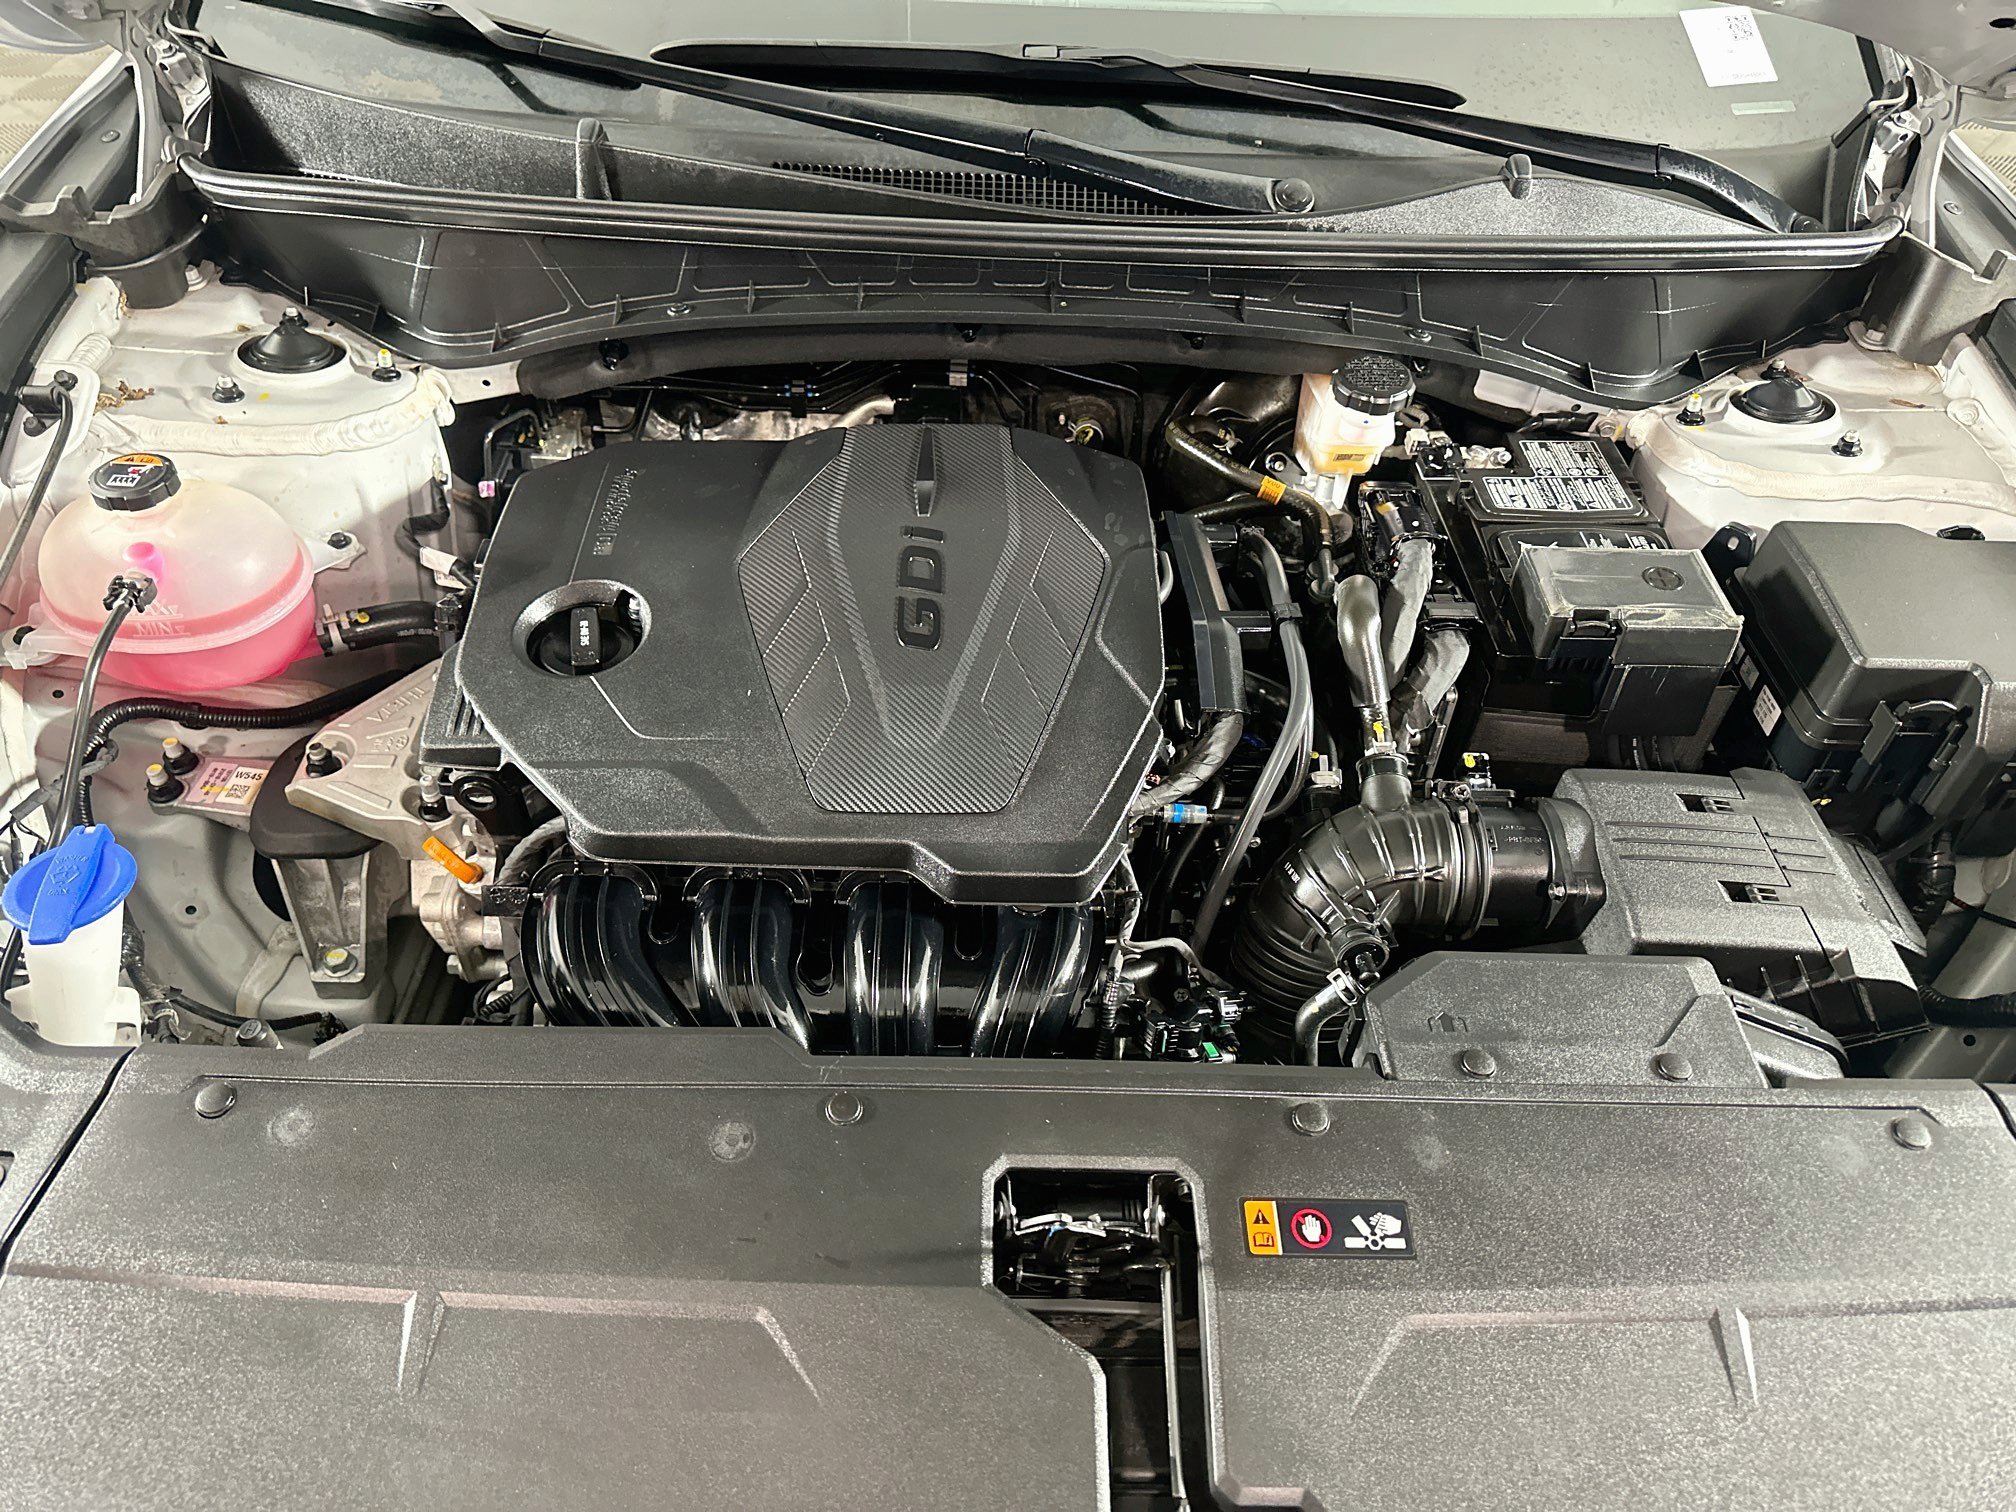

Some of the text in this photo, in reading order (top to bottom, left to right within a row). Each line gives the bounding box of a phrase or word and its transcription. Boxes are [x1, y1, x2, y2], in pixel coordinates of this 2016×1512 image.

[895, 525, 944, 651] GDI
[136, 622, 174, 636] MIN
[235, 770, 264, 781] W545
